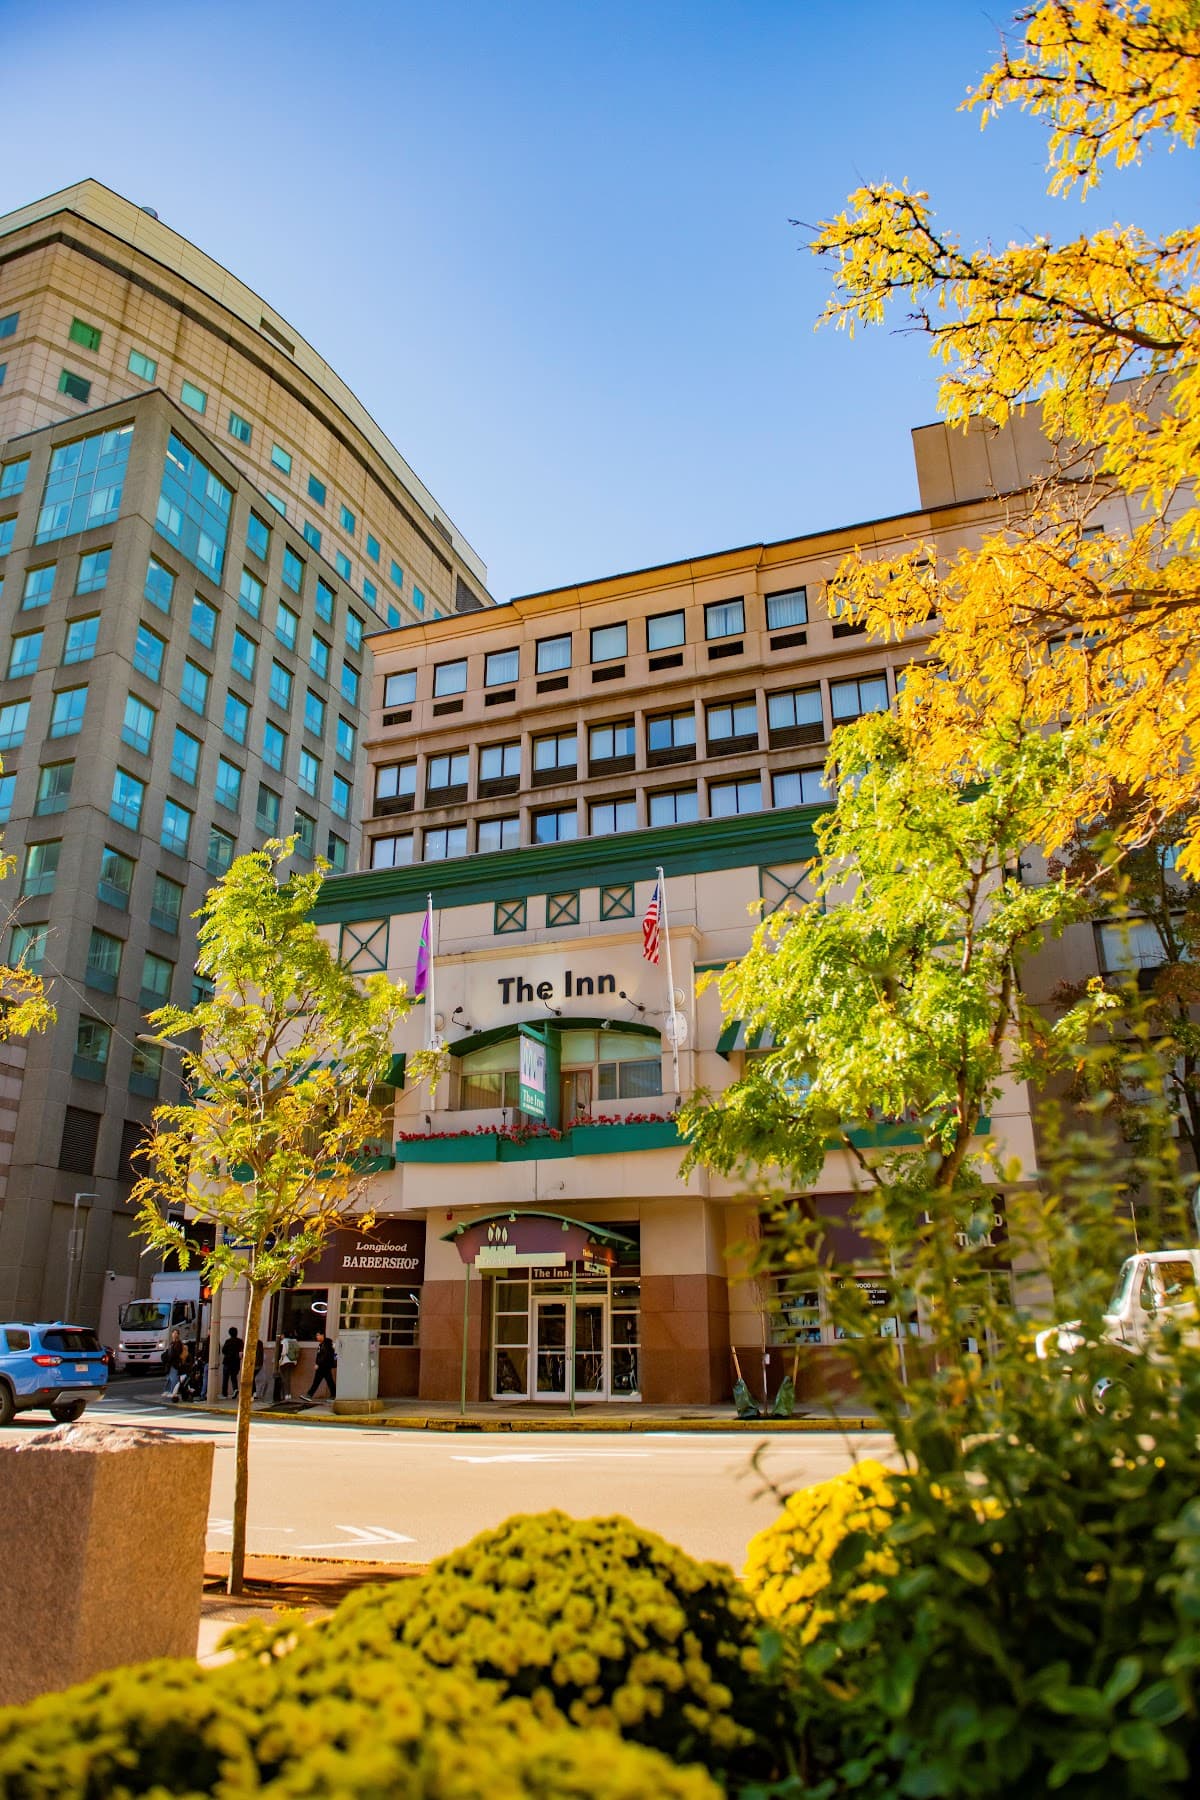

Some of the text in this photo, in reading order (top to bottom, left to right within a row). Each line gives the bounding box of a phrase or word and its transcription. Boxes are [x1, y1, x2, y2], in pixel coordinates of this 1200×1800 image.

[498, 970, 616, 1005] The Inn
[522, 1089, 534, 1105] The
[534, 1094, 545, 1110] Inn
[356, 1241, 408, 1253] Longwood
[342, 1255, 420, 1270] BARBERSHOP
[534, 1268, 551, 1278] The
[553, 1267, 570, 1278] Inn
